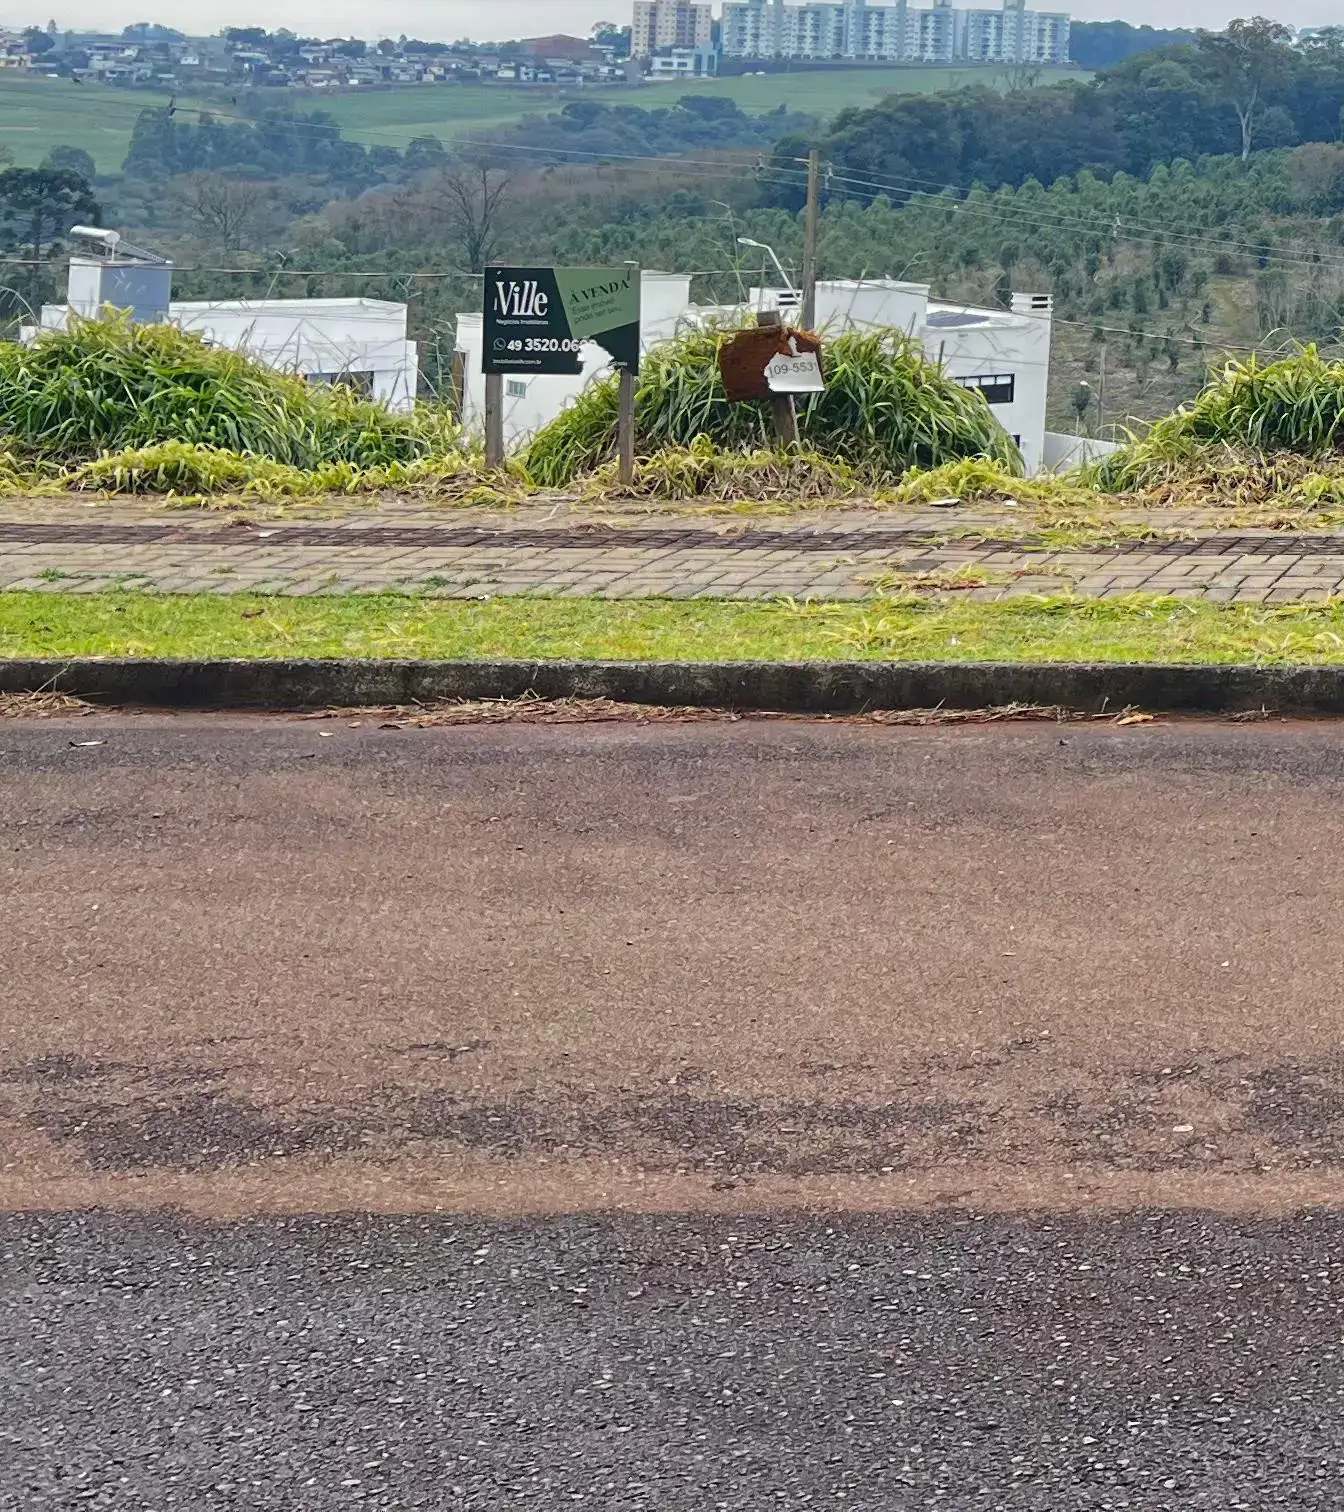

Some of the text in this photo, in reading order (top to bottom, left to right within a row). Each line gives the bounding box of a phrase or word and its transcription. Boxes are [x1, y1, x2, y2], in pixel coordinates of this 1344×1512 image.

[495, 281, 548, 316] Ville
[581, 279, 630, 299] VENDA
[507, 340, 522, 351] 49
